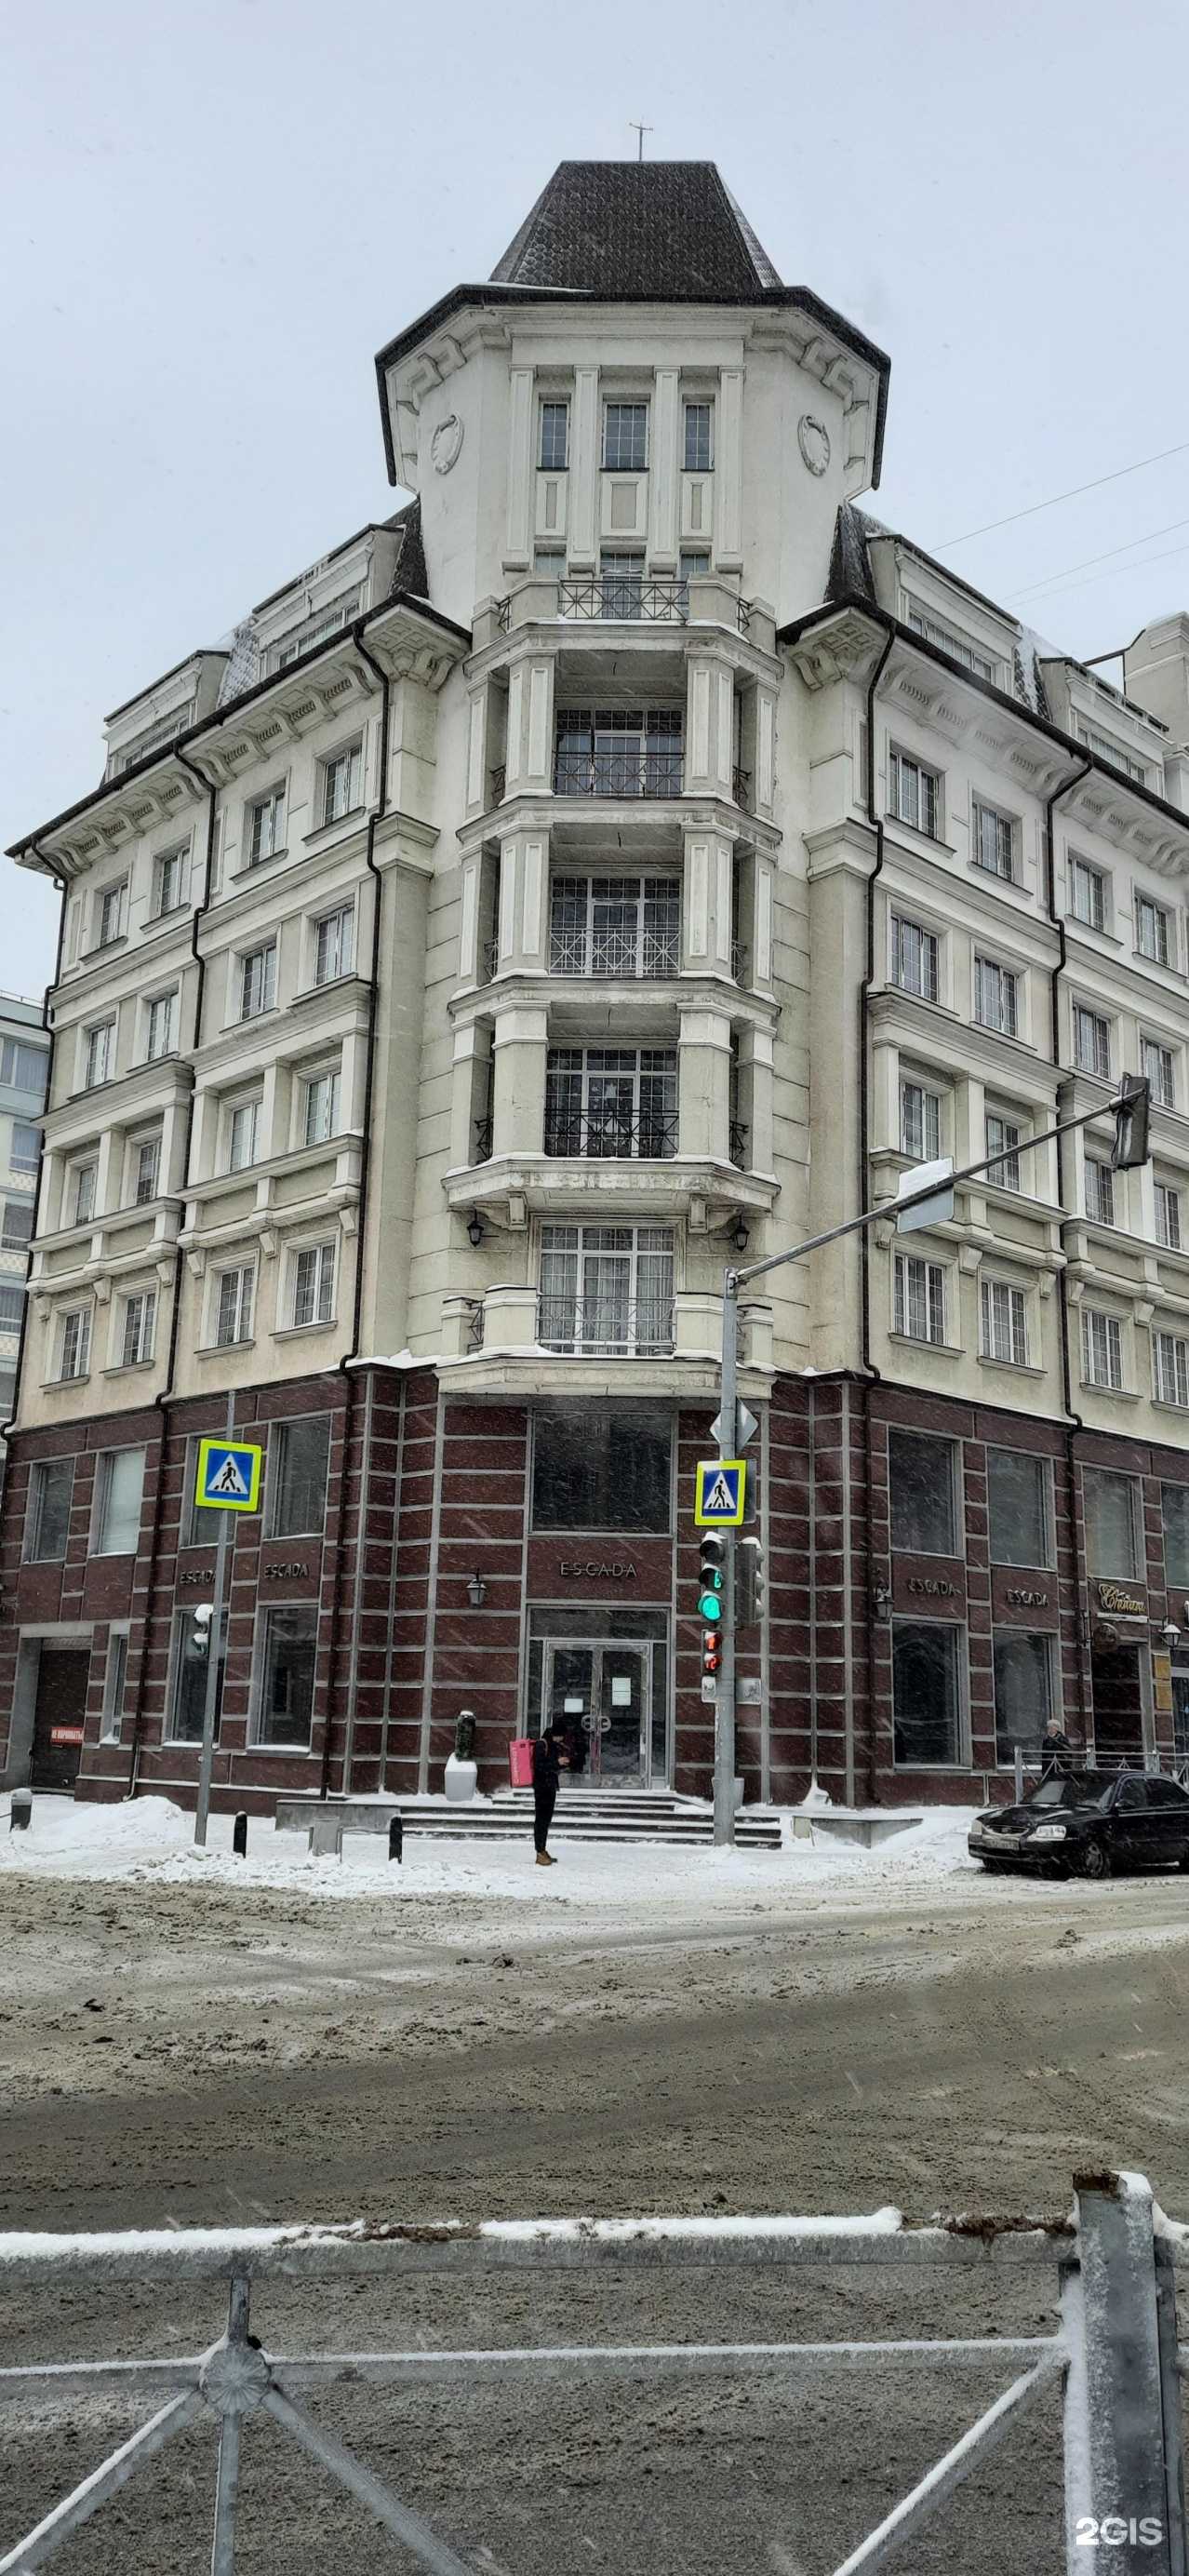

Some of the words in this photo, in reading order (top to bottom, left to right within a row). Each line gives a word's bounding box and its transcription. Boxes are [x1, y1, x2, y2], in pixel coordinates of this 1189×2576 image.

[264, 1563, 309, 1579] ESCADA
[560, 1562, 636, 1576] ESCADA
[907, 1577, 956, 1595] ESCADA
[1006, 1589, 1049, 1606] ESCADA
